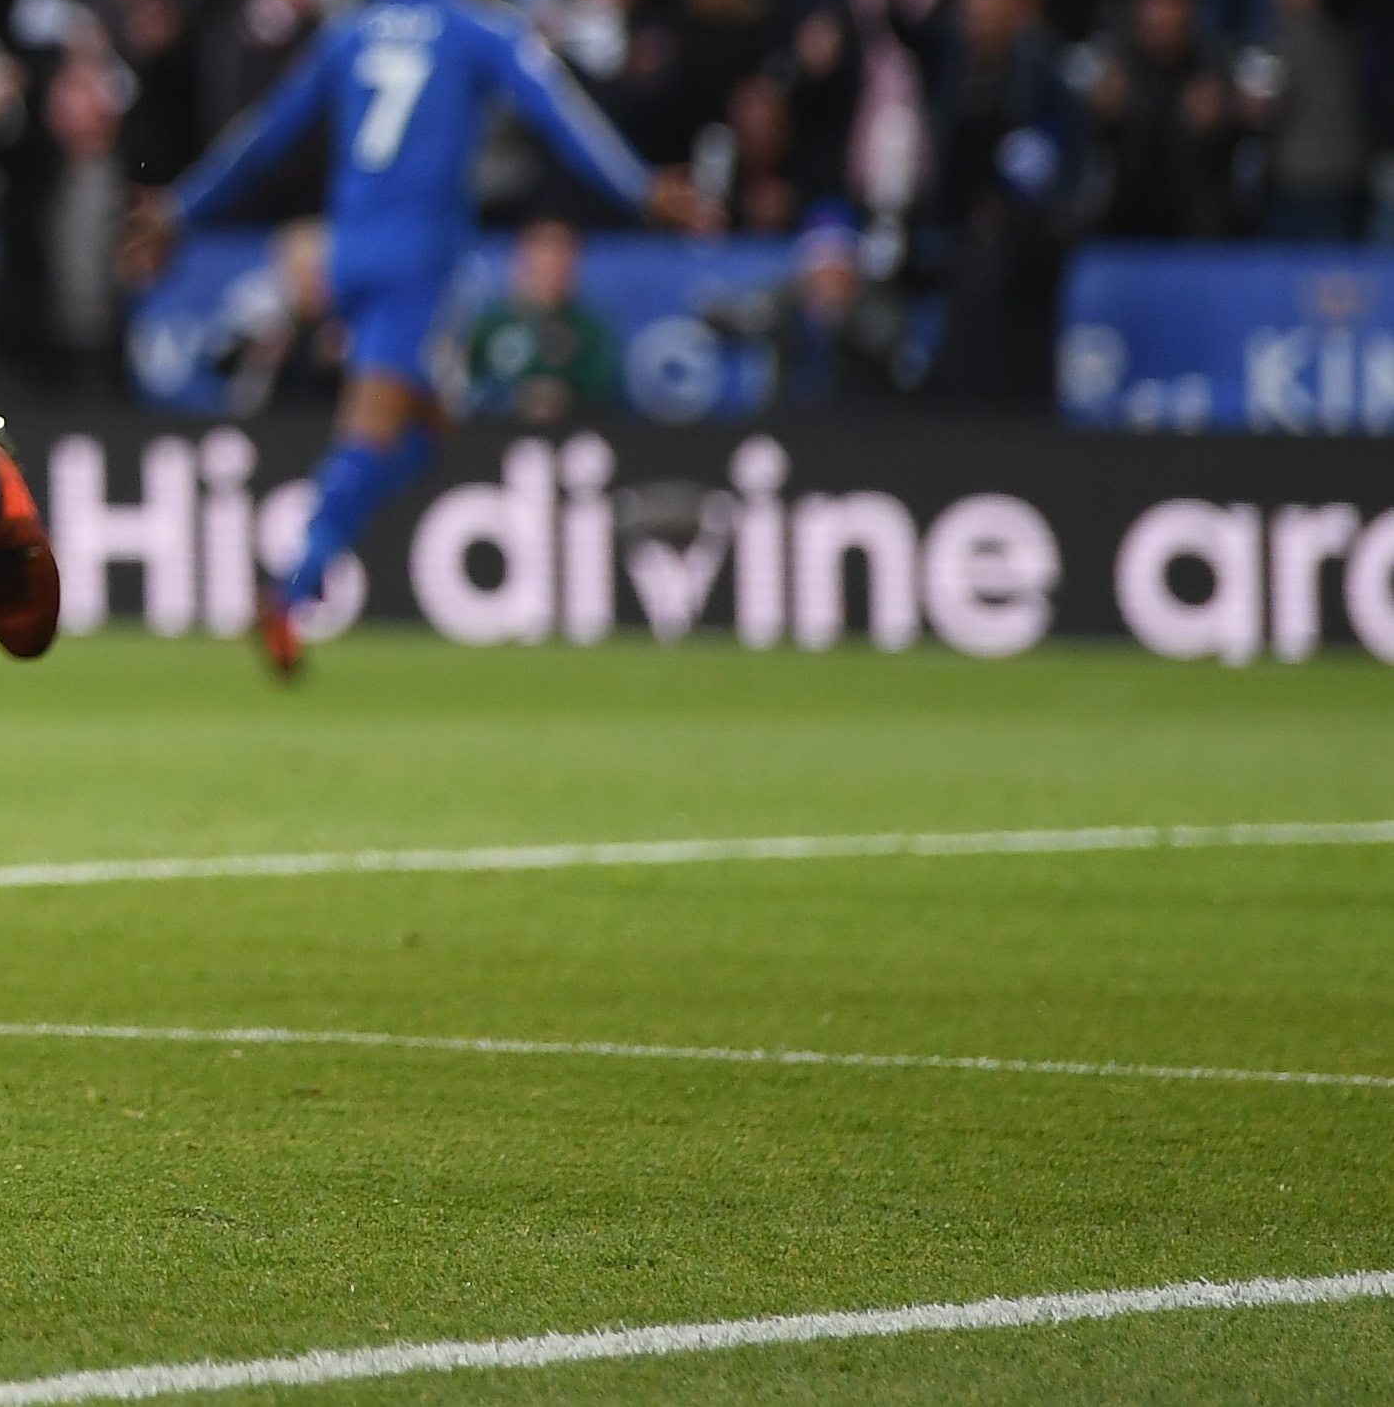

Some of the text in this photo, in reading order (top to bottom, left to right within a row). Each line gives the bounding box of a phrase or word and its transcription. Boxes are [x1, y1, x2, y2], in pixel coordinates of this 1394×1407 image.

[352, 43, 434, 174] 7
[49, 425, 367, 641] His
[413, 433, 1062, 659] divine
